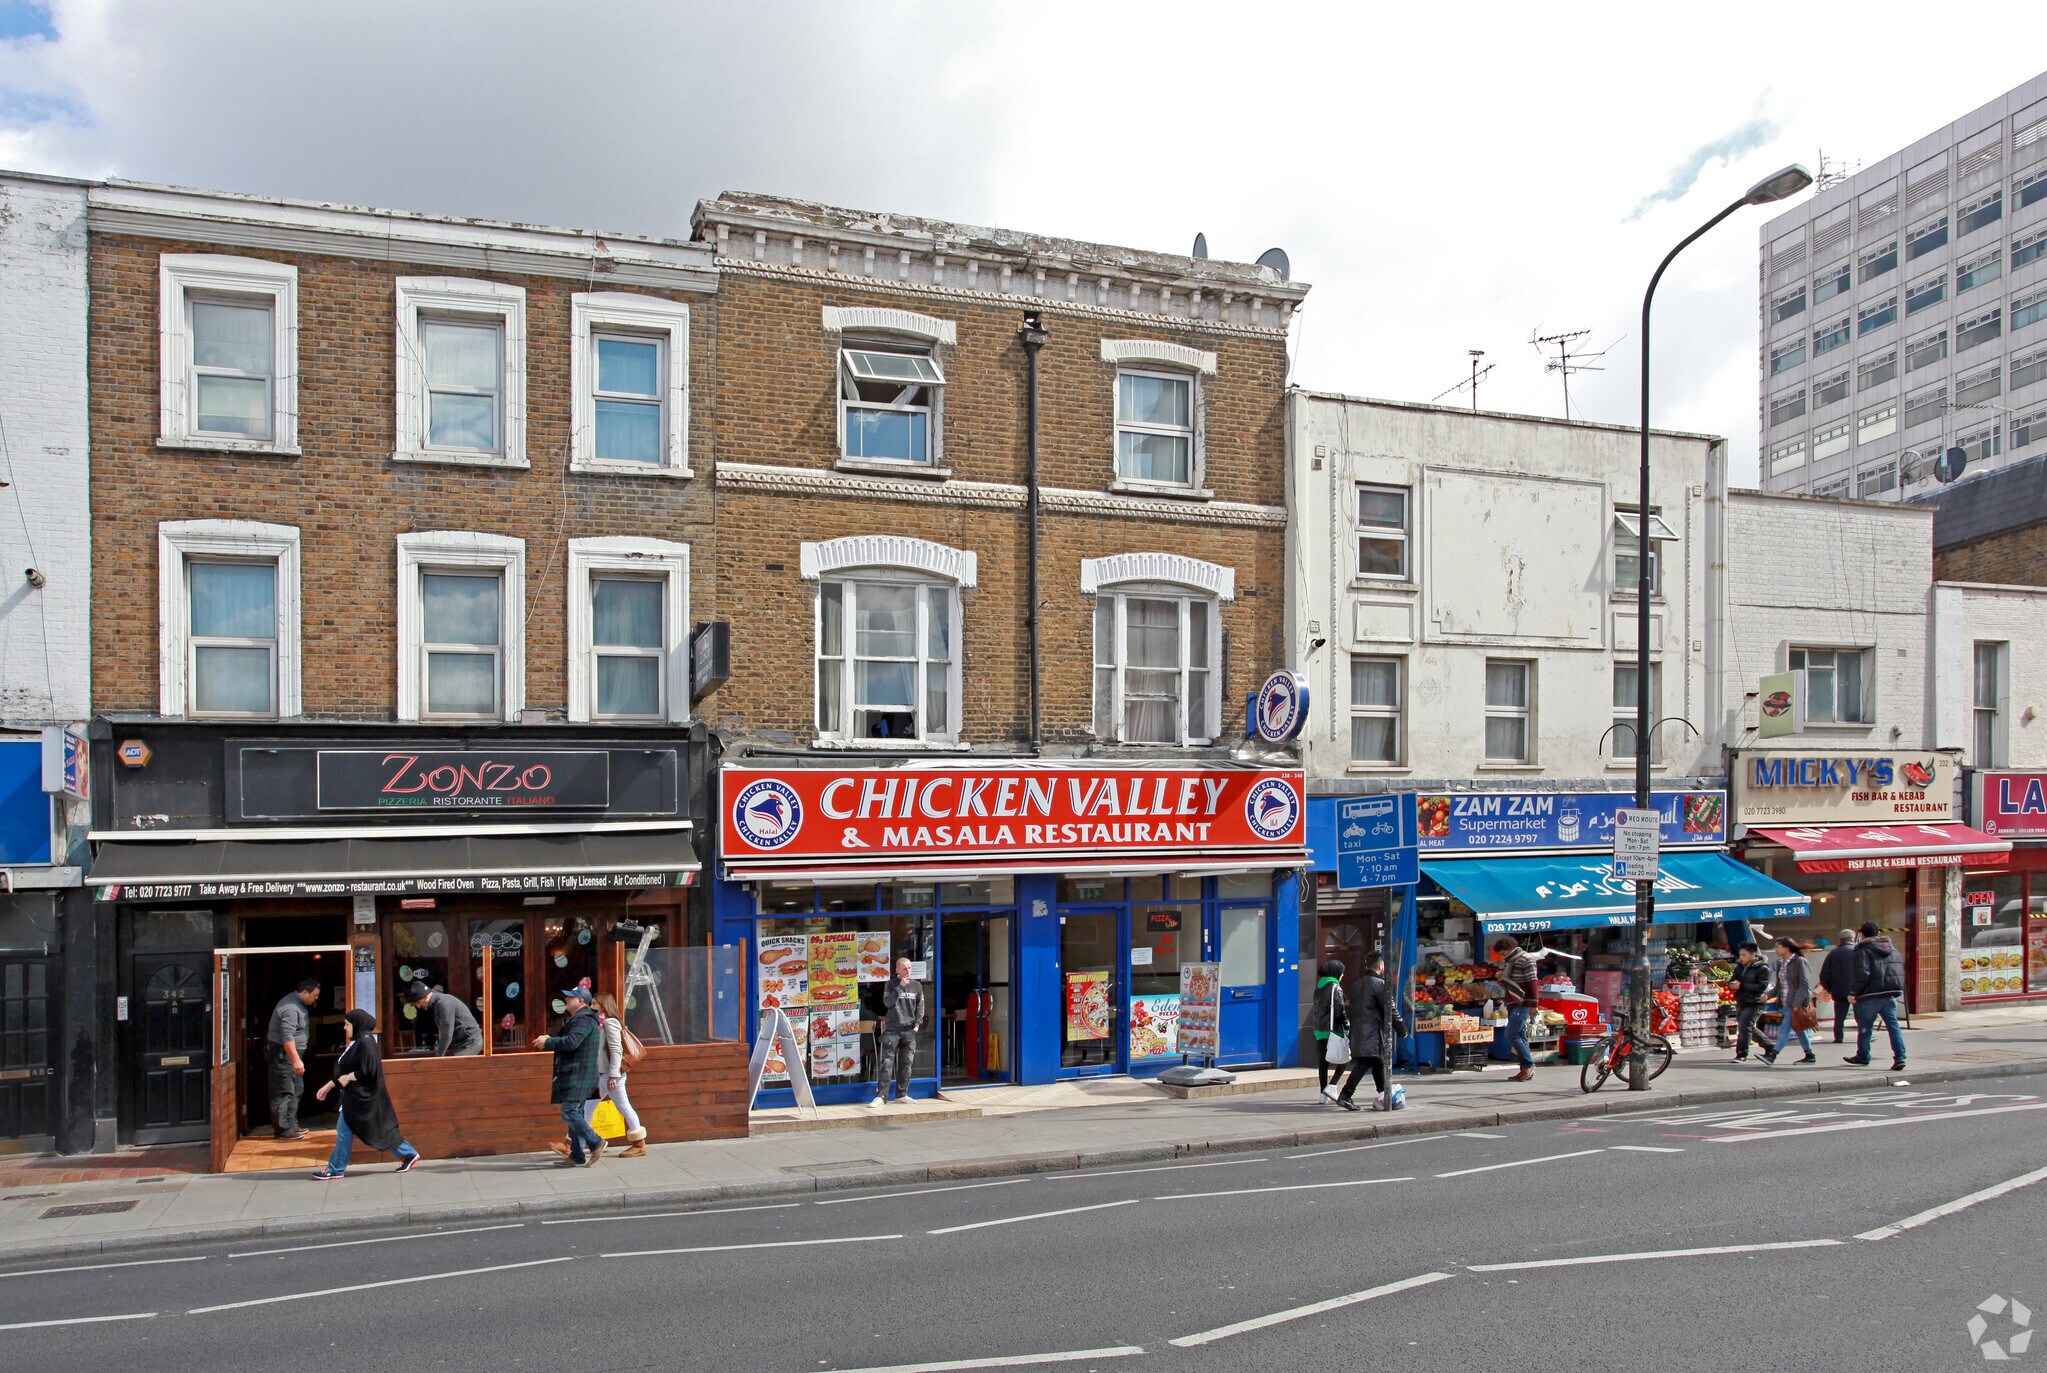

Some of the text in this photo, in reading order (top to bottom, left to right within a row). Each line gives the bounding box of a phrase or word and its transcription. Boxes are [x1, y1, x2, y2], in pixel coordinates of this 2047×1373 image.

[125, 748, 141, 756] ADT
[1753, 757, 1894, 787] MICKY'S
[739, 783, 799, 810] CHICKEN VALLEY
[819, 777, 1229, 819] CHICKEN VALLEY
[1249, 781, 1296, 805] CHICKEN VALLEY
[1851, 791, 1925, 801] FISH BAR & KEBAB
[378, 796, 556, 806] PIZZERIA RISTORANTE ITALIANO
[1453, 797, 1502, 816] ZAM
[1507, 796, 1554, 816] ZAM
[1744, 807, 1786, 816] 020 7723 3980
[1893, 803, 1948, 813] RESTAURANT
[1249, 814, 1275, 837] CHICKEN
[1276, 814, 1295, 836] VALLEY
[1459, 818, 1546, 833] Supermarket
[739, 820, 797, 846] CHICKEN VALLEY
[841, 822, 1212, 848] & MASALA RESTAURANT
[1631, 831, 1652, 839] stopping
[1343, 839, 1362, 849] taxi
[1468, 834, 1538, 844] 020 7224 9797
[1356, 855, 1377, 864] Mon
[1383, 852, 1401, 861] Sat
[1848, 855, 1962, 869] FISH BAR & KEBAB RESTAURANT
[1358, 866, 1365, 874] 7
[1371, 864, 1382, 873] 10
[1361, 875, 1368, 883] 4
[1374, 874, 1380, 882] 7
[1382, 874, 1396, 882] pm
[124, 886, 138, 899] Tel:
[139, 885, 153, 898] 020
[154, 885, 173, 897] 7723
[174, 885, 192, 897] 9777
[199, 884, 216, 895] Take
[218, 883, 239, 896] Away
[240, 883, 246, 894] &
[247, 882, 264, 893] Free
[265, 882, 295, 895] Delivery
[416, 879, 437, 890] Wood
[438, 878, 455, 890] Fired
[456, 878, 475, 889] Oven
[481, 878, 501, 890] Pizza,
[502, 878, 522, 890] Pasta,
[523, 877, 540, 889] Grill,
[540, 877, 555, 888] Fish
[562, 876, 577, 889] Fully
[579, 875, 607, 887] Licensed
[613, 875, 624, 886] Air
[624, 874, 662, 886] Conditioned
[1967, 892, 1994, 905] OPEN
[1773, 907, 1787, 916] 334
[1792, 907, 1805, 915] 336
[1608, 916, 1629, 925] HALAL
[1487, 920, 1551, 932] 020 7224 9797
[761, 937, 780, 947] QUICK
[780, 937, 805, 945] SNACKS
[824, 933, 856, 943] SPECIALS
[1069, 975, 1088, 984] FRESH
[163, 990, 186, 999] 342
[47, 1067, 54, 1075] C
